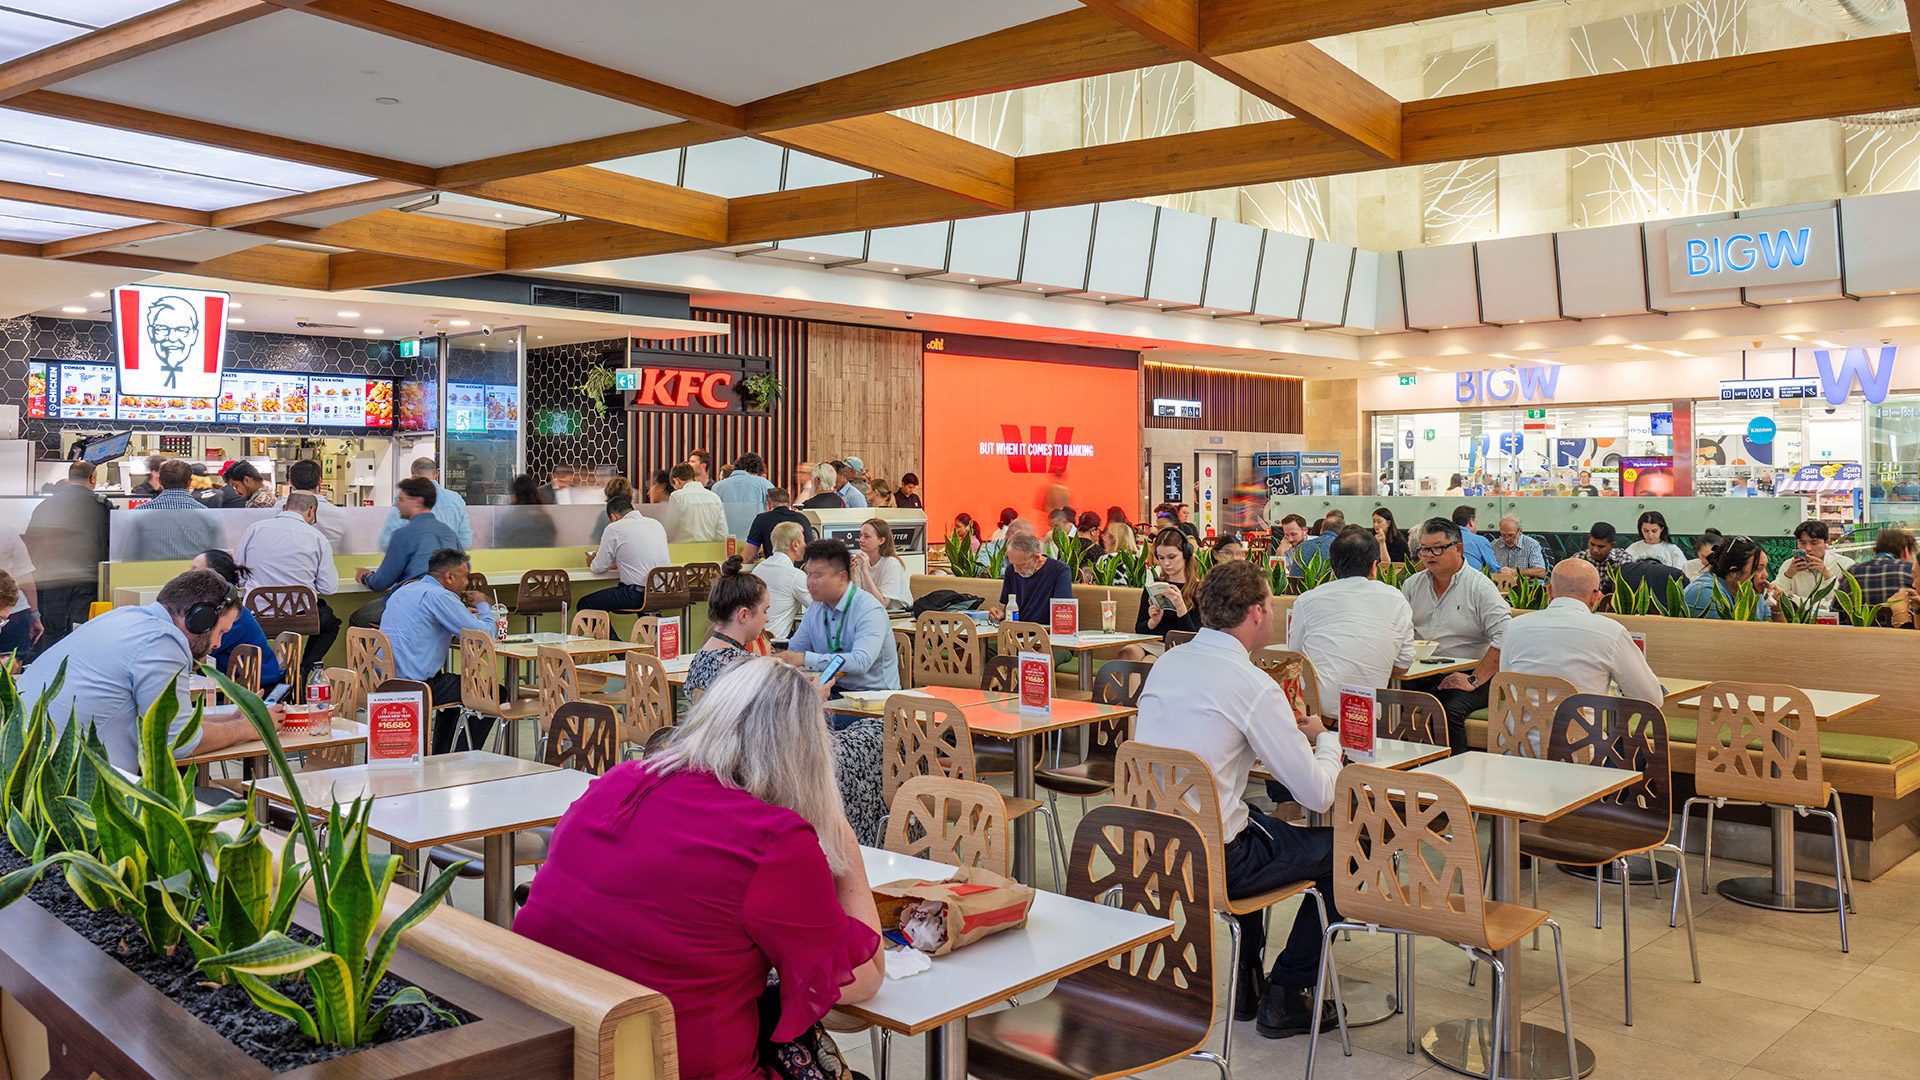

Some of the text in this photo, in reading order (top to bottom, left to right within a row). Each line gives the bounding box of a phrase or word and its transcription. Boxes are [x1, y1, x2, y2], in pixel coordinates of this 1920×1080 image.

[48, 366, 58, 404] CHICKEN
[637, 367, 733, 410] KFC
[1813, 346, 1898, 405] W
[979, 442, 1094, 457] BUT WHEN IT COMES TO BANKING
[1267, 474, 1290, 487] Card
[1271, 485, 1288, 495] Bot
